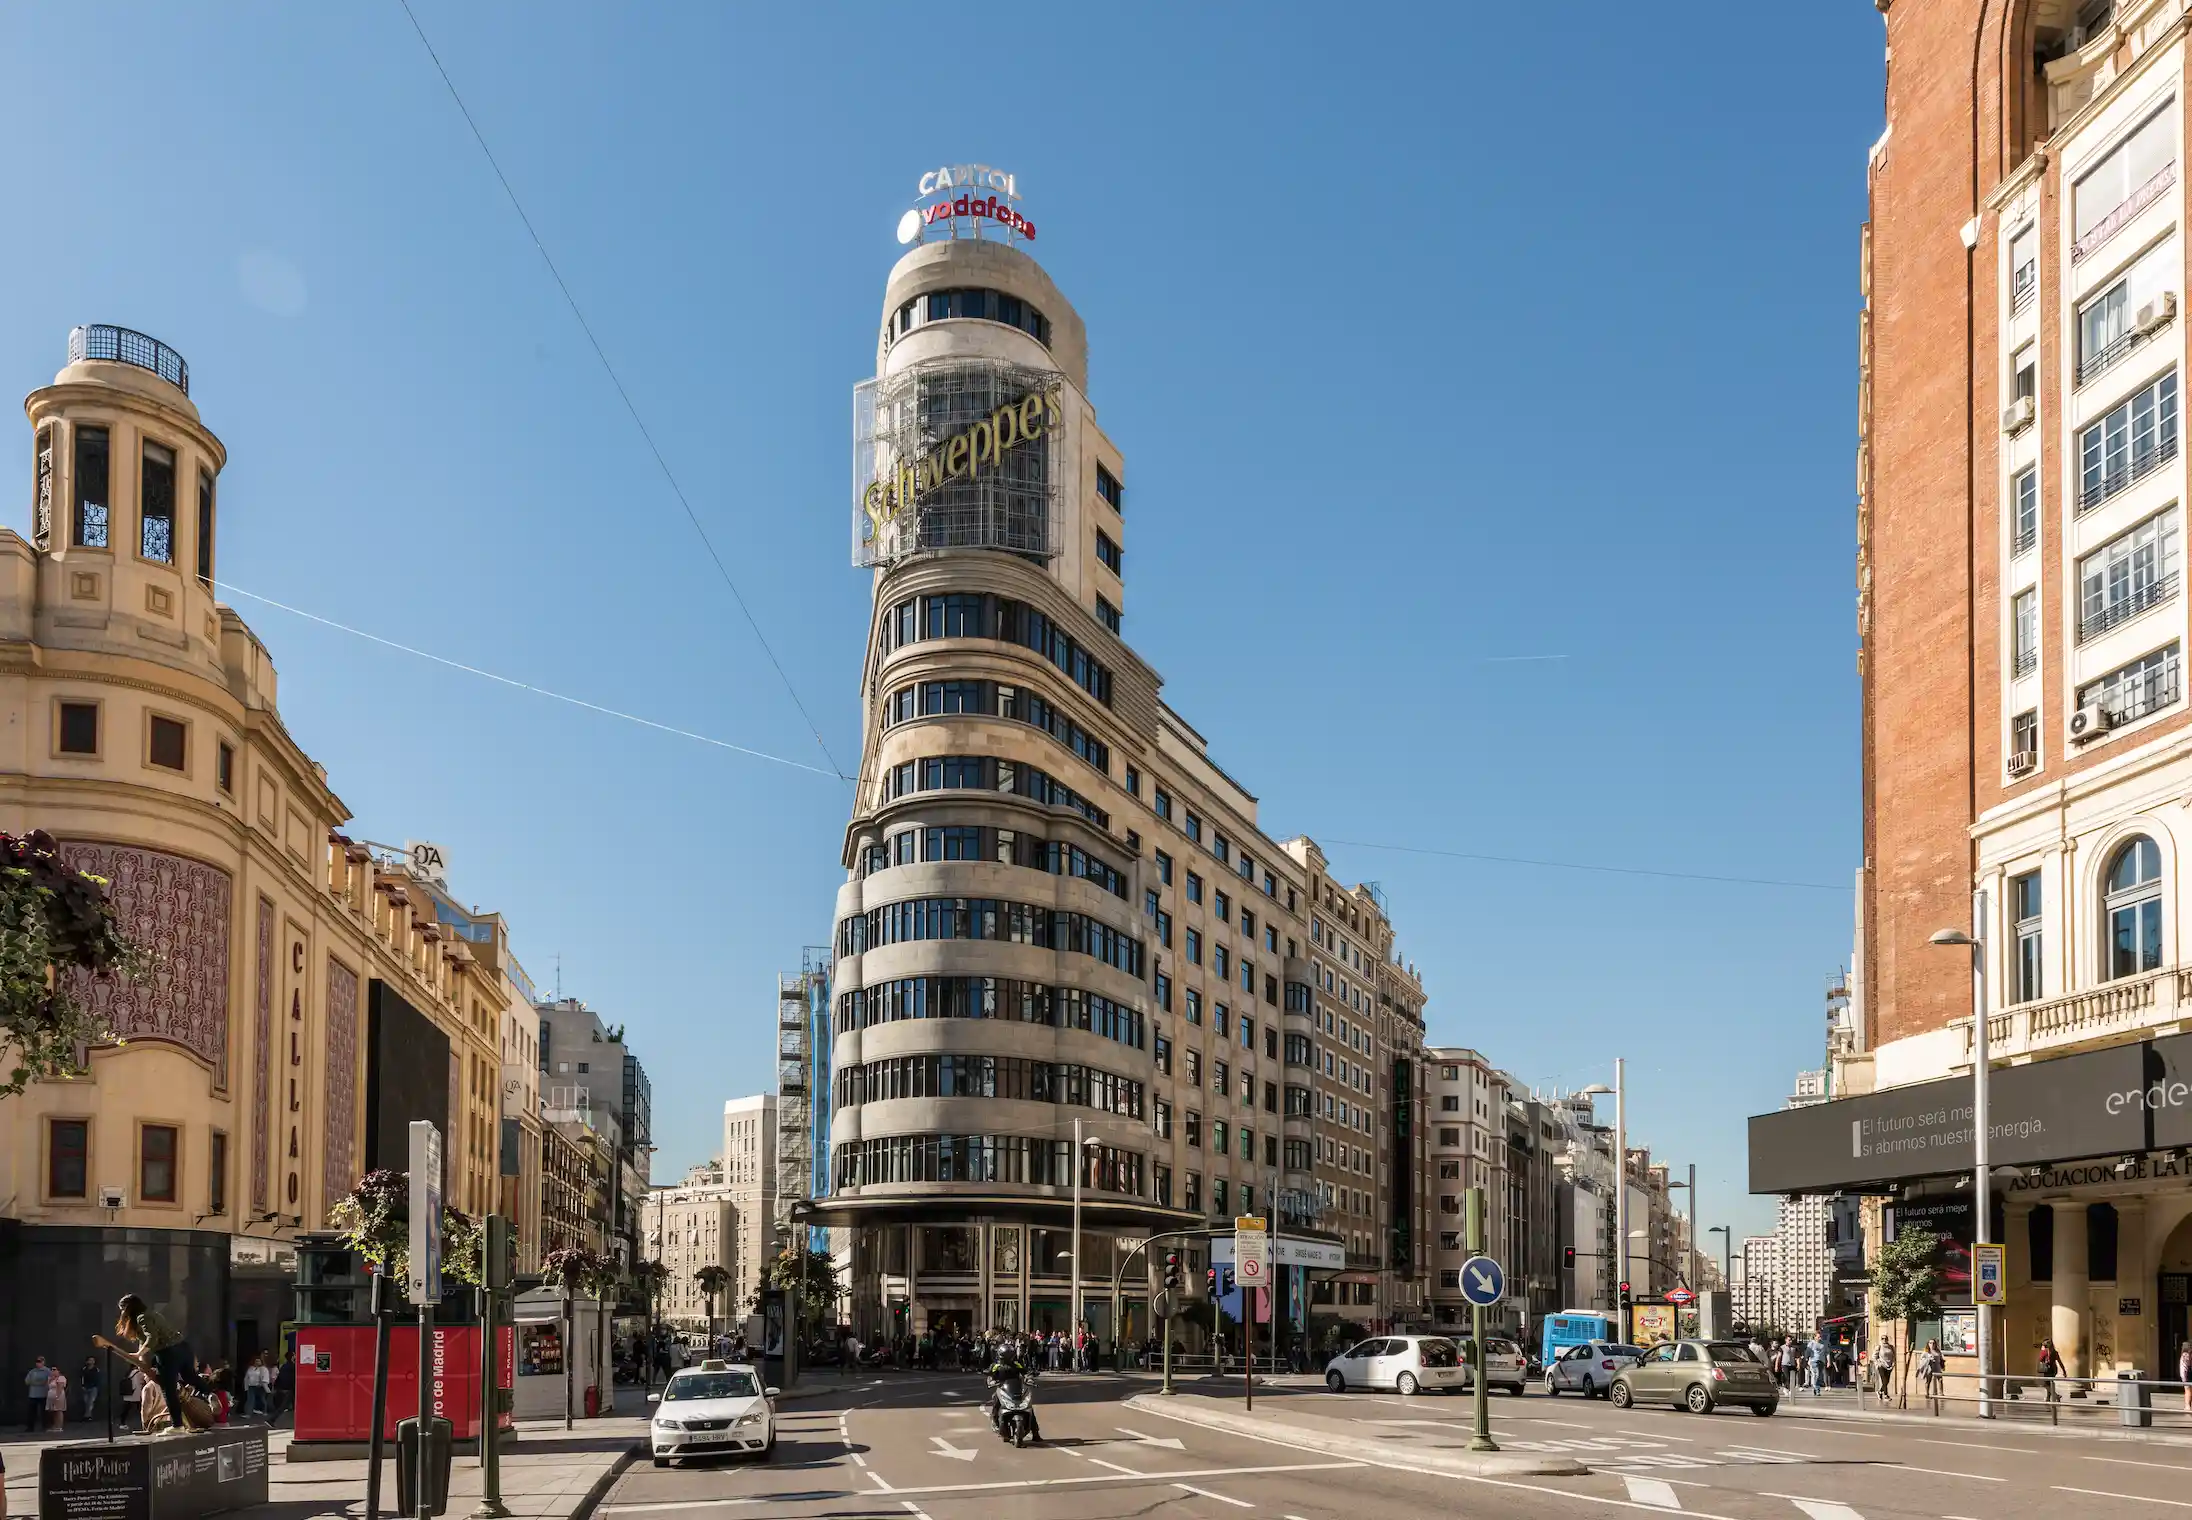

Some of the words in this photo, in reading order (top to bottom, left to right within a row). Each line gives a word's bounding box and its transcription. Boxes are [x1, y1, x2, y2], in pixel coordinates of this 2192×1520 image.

[919, 163, 1022, 200] CAPITOL
[922, 194, 1036, 241] vodafone
[863, 382, 1062, 547] Schweppes
[288, 941, 303, 1204] CALLAO
[2105, 1077, 2192, 1115] ende
[1863, 1119, 1873, 1135] El
[1876, 1116, 1915, 1133] futuro
[1918, 1108, 1946, 1127] será
[1863, 1139, 1873, 1157] si
[1876, 1136, 1926, 1156] abrimos
[1987, 1116, 2047, 1139] energía.
[2009, 1164, 2117, 1192] ASOCIACION
[2123, 1160, 2147, 1181] DE
[2153, 1156, 2180, 1178] LA
[1896, 1207, 1904, 1218] El
[1904, 1207, 1926, 1217] futuro
[1928, 1204, 1944, 1215] será
[1946, 1204, 1968, 1215] mejor
[433, 1331, 445, 1377] Madrid
[433, 1380, 444, 1397] de
[1497, 1437, 1669, 1452] BUS
[63, 1461, 95, 1482] Harry
[96, 1457, 131, 1480] Potter
